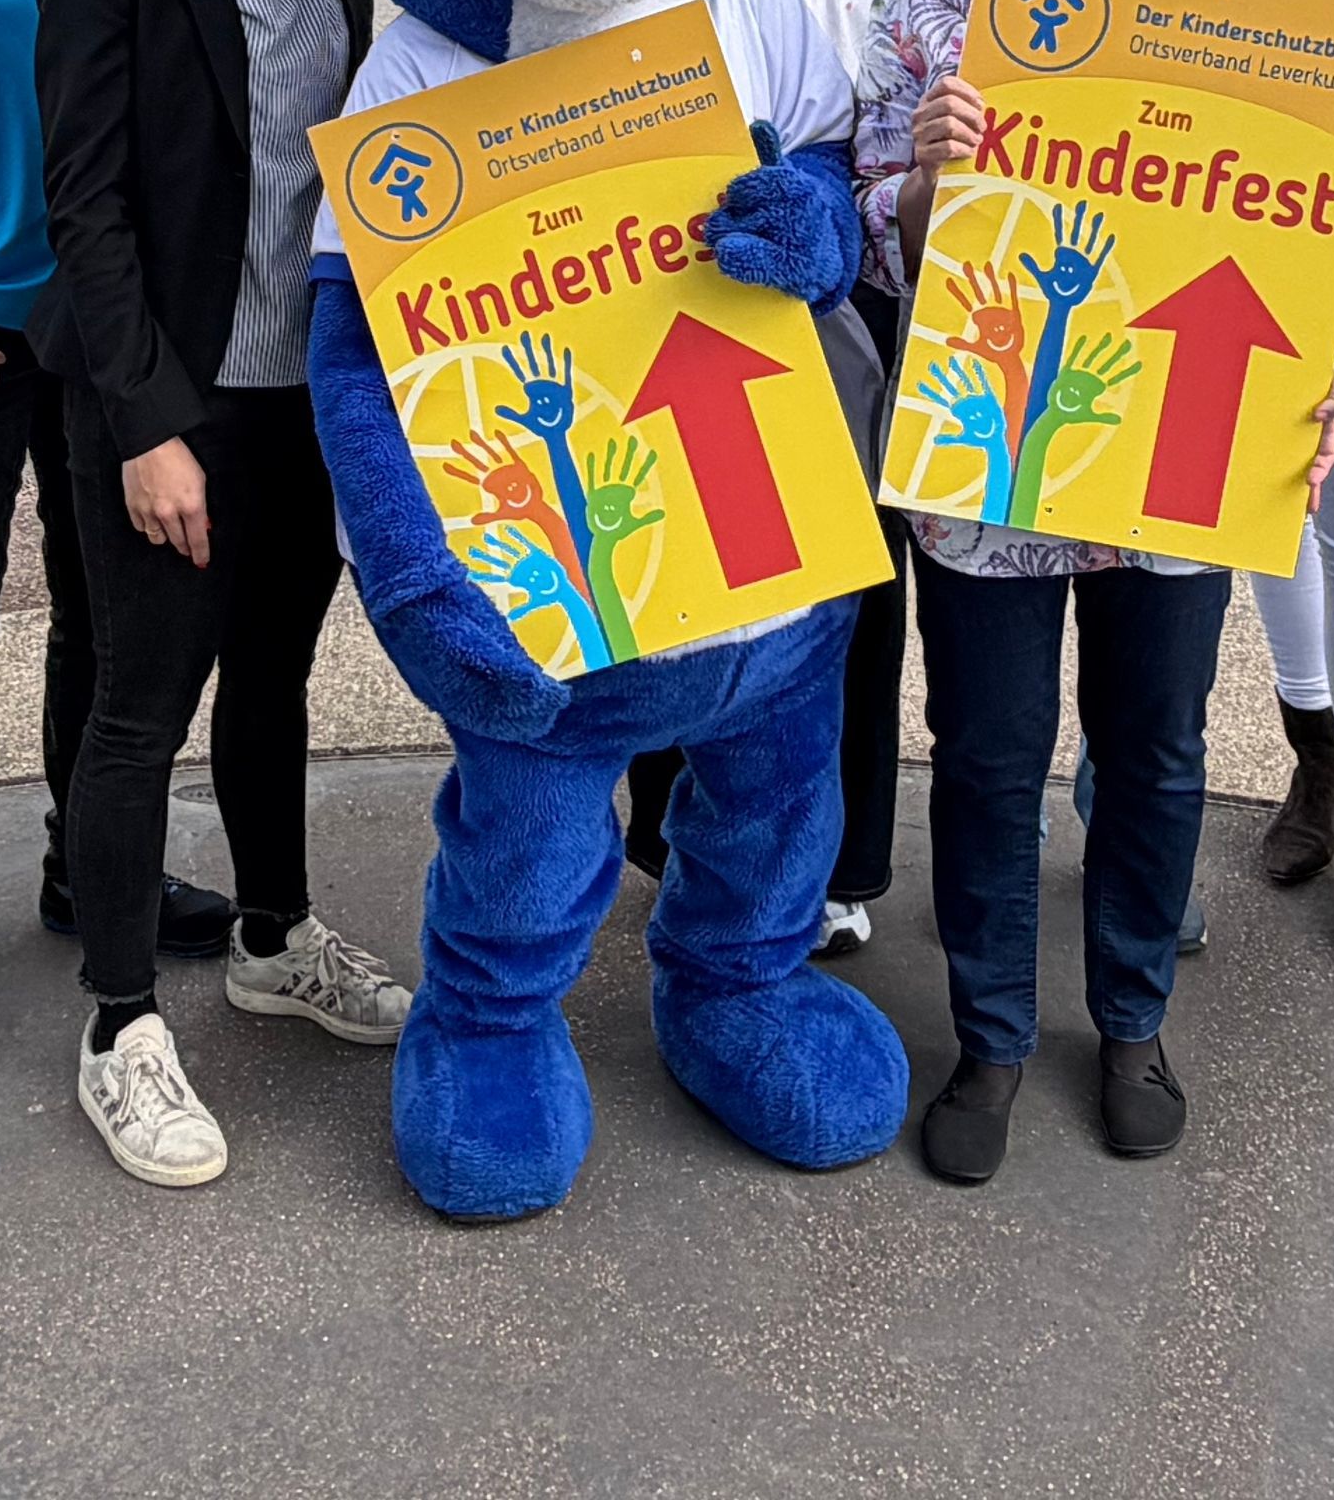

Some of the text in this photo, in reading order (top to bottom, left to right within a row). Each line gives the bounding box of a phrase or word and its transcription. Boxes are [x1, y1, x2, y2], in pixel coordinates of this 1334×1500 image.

[1135, 4, 1174, 29] Der
[1129, 33, 1252, 75] Ortsverband
[477, 56, 713, 151] Der Kinderschutzbund
[1137, 99, 1193, 133] Zum
[487, 92, 719, 180] Ortsverband Leverkusen
[528, 203, 584, 237] Zum
